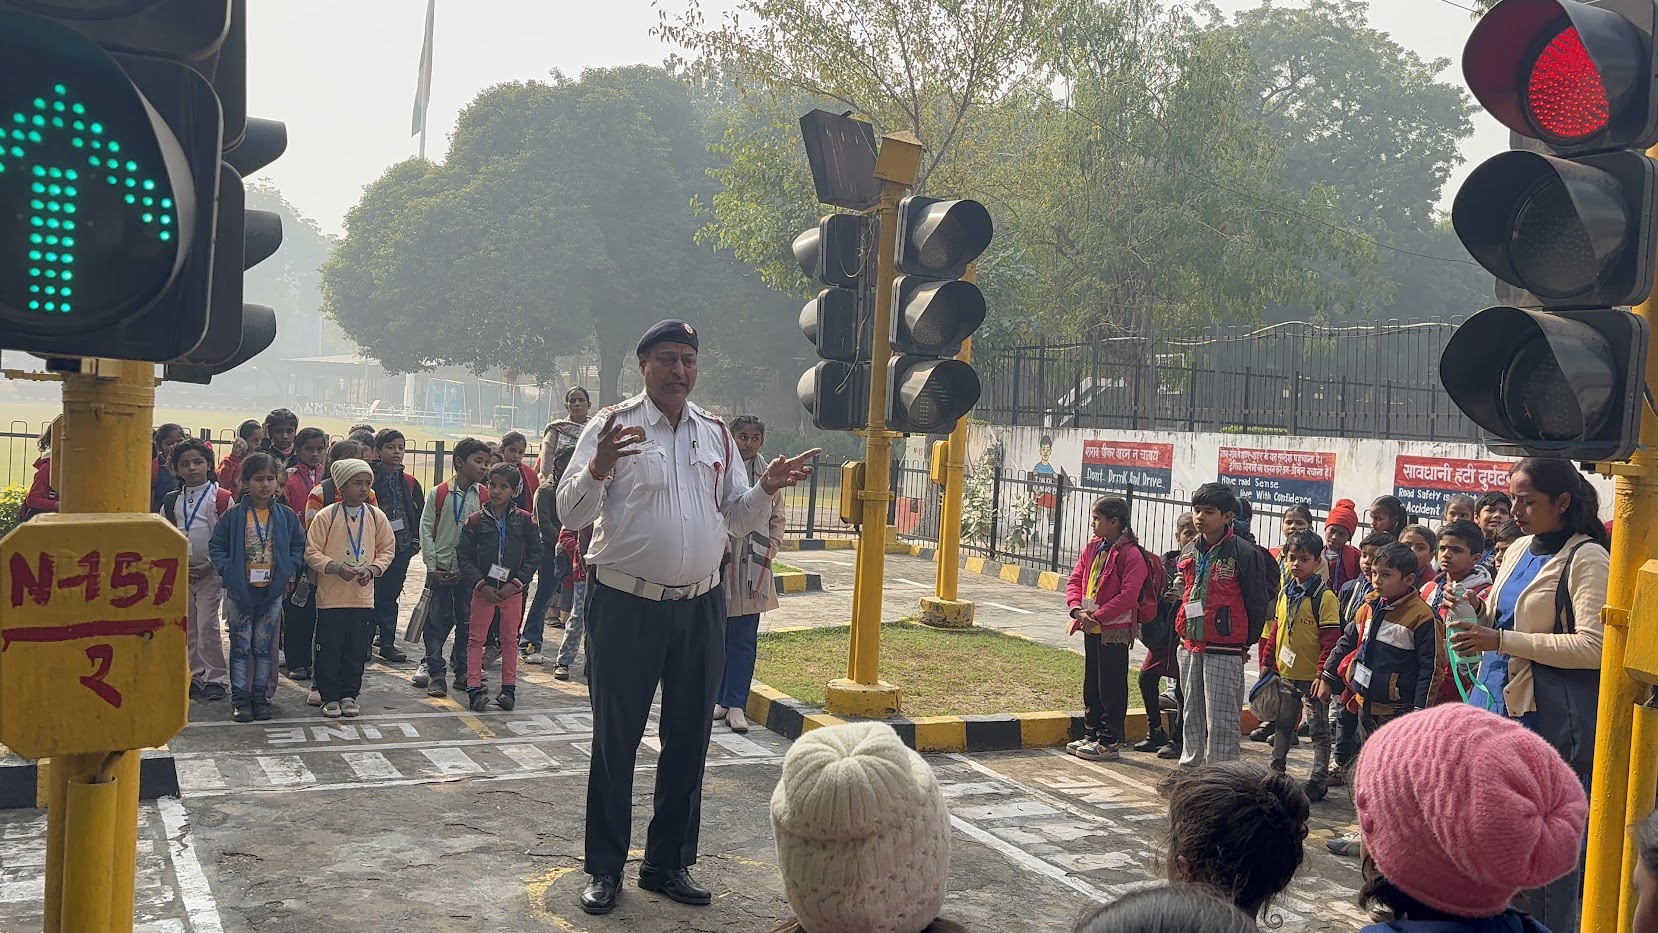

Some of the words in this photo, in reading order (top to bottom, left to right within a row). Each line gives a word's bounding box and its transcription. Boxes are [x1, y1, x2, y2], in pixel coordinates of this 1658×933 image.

[1115, 448, 1131, 461] वाहन
[1132, 449, 1139, 460] न
[1142, 472, 1163, 488] Drive
[1221, 475, 1236, 485] Have
[1238, 477, 1251, 486] road
[1254, 478, 1279, 489] Sense
[1403, 462, 1453, 482] सावधानी
[1454, 463, 1476, 487] हटी
[1256, 490, 1272, 500] With
[1273, 491, 1312, 505] Confidence
[1398, 487, 1415, 498] Road
[1405, 501, 1441, 516] Accident
[9, 549, 179, 609] N-157
[264, 721, 421, 744] LINE
